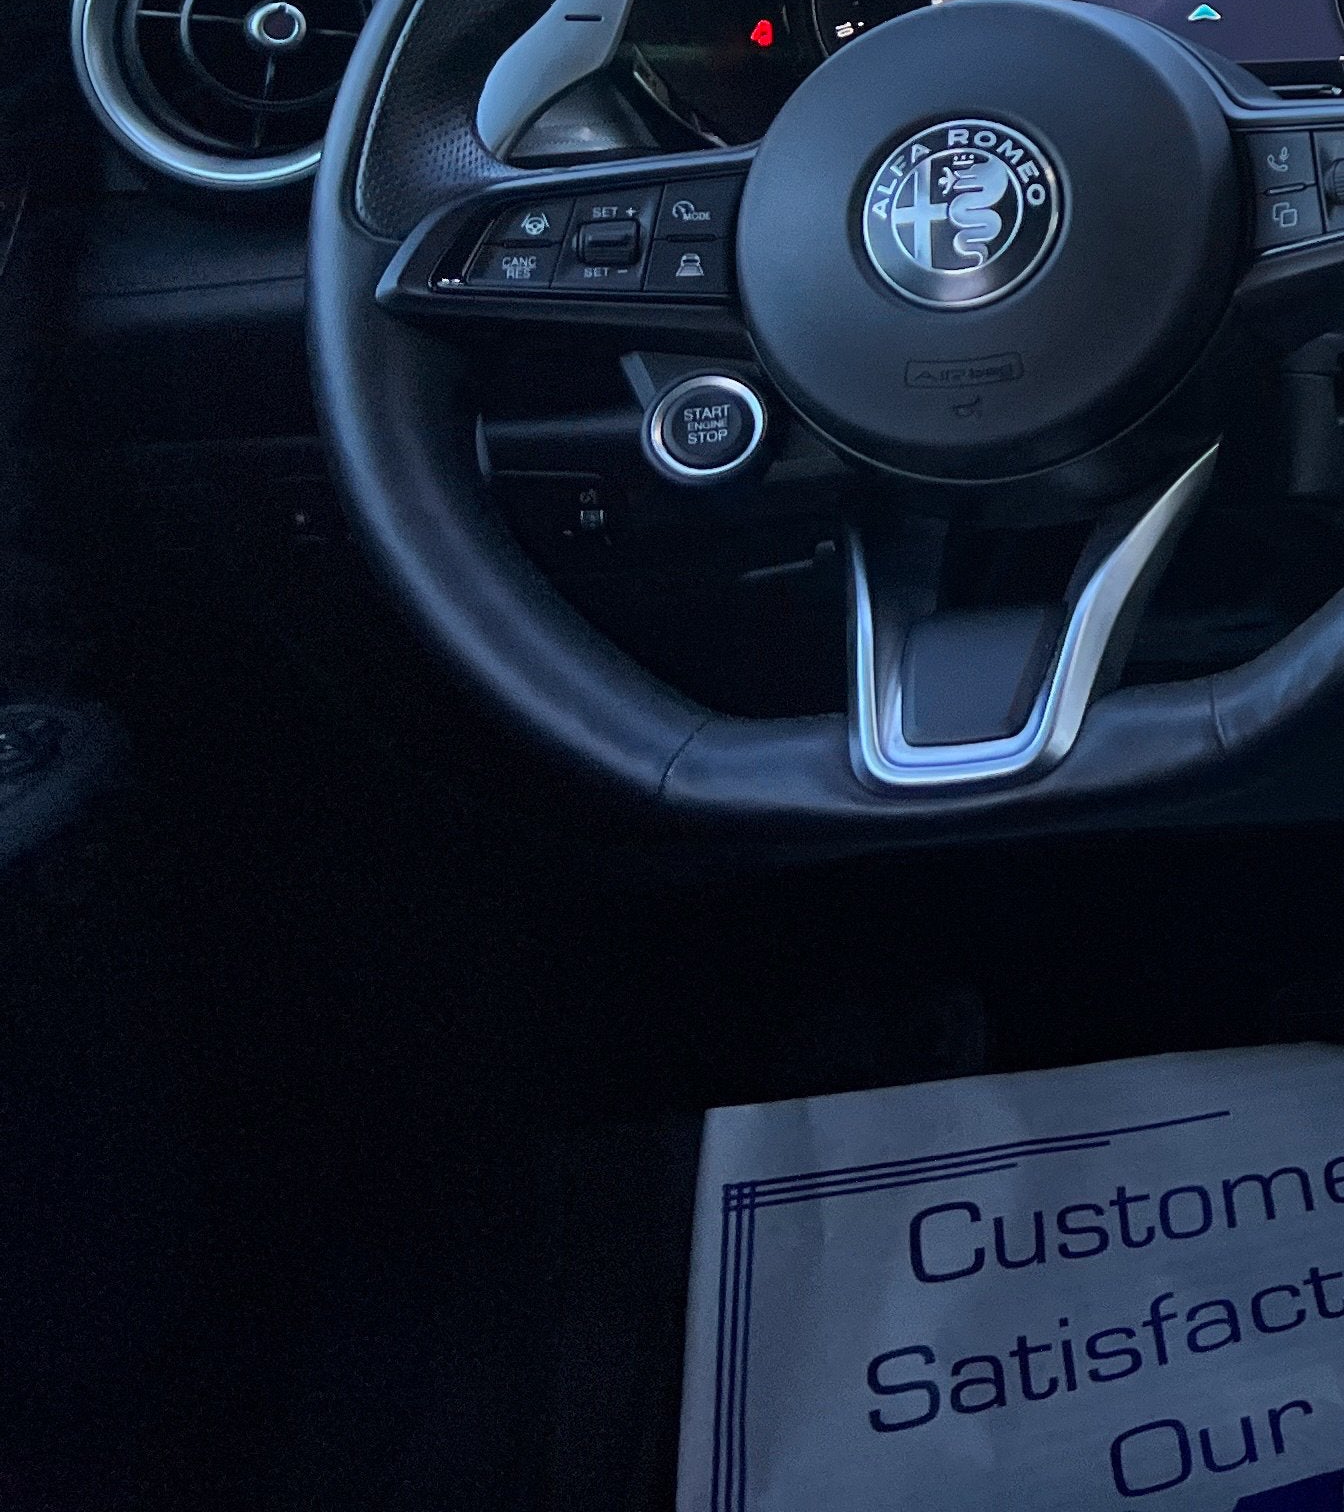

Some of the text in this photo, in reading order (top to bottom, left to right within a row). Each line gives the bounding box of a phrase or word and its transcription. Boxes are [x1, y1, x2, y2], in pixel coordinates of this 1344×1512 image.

[835, 21, 854, 38] 10
[871, 128, 1046, 220] ALFA ROMEO
[592, 207, 618, 218] SET
[682, 211, 711, 221] MODE
[501, 256, 537, 269] CANC
[506, 267, 531, 279] RES
[583, 267, 609, 278] SET
[683, 404, 730, 422] START
[687, 418, 728, 431] ENGINE
[687, 429, 728, 445] STOP
[1108, 1398, 1314, 1498] Our
